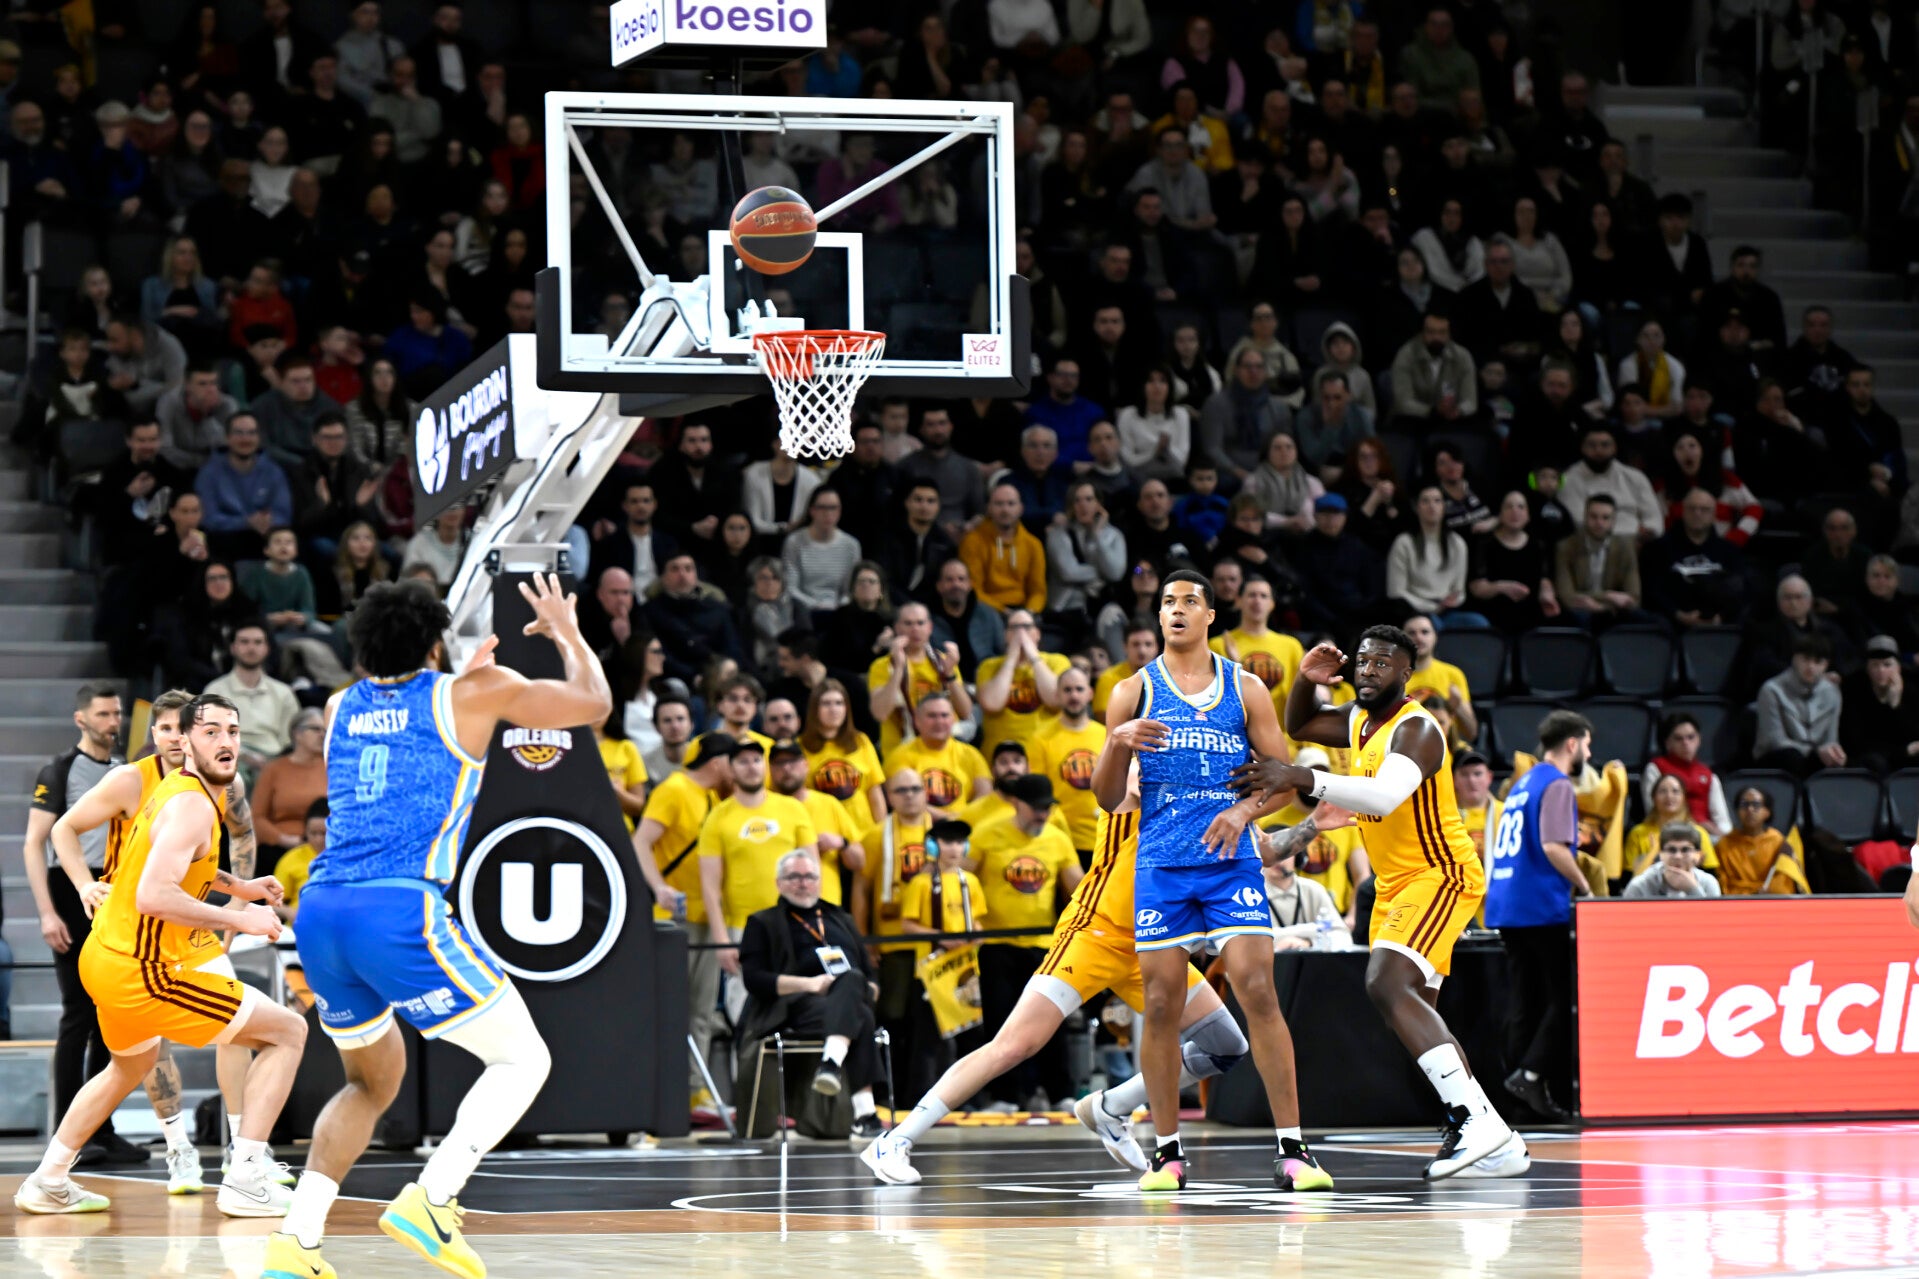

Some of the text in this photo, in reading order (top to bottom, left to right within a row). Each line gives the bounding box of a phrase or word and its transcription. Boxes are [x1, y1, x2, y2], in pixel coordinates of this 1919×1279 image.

[676, 0, 813, 33] koesio
[1174, 726, 1231, 738] ANTIBES
[354, 744, 390, 802] 9
[1199, 751, 1211, 777] 5
[1493, 809, 1525, 860] 03
[501, 862, 583, 945] U
